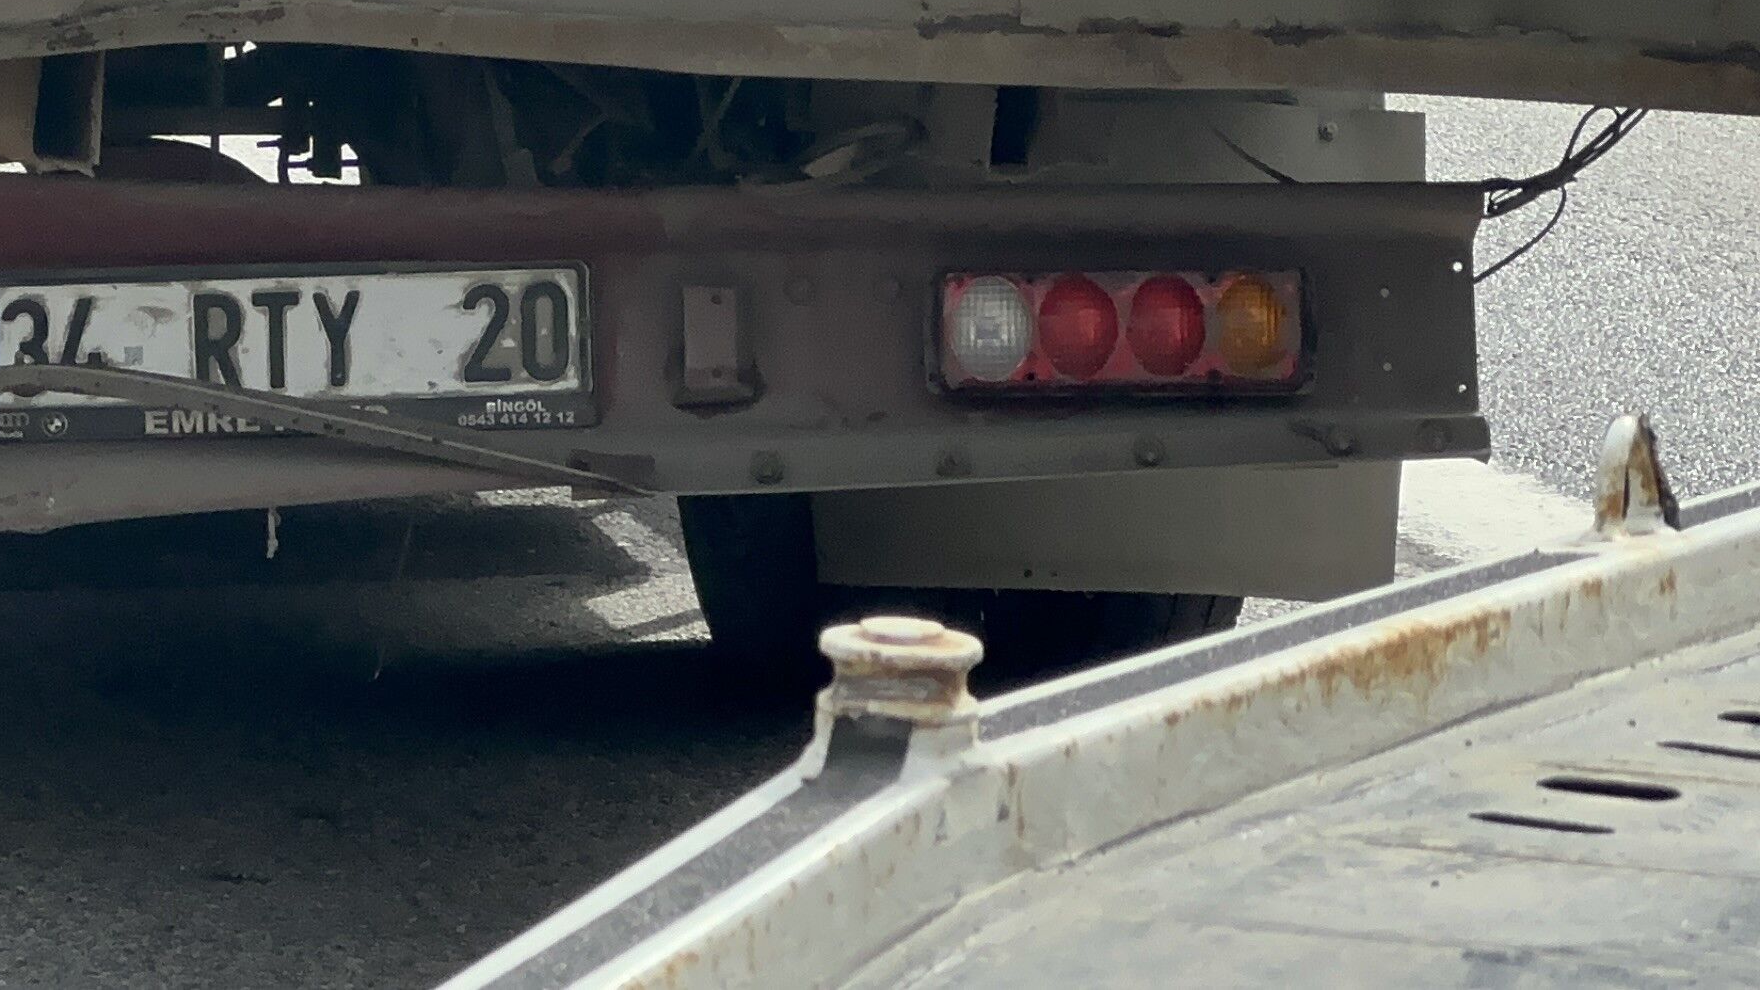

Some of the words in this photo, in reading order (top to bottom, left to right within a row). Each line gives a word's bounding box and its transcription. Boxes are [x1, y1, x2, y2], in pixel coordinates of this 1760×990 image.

[193, 290, 360, 389] RTY
[462, 281, 570, 383] 20
[457, 413, 496, 427] 0543
[500, 412, 528, 425] 414
[533, 411, 552, 424] 12
[556, 410, 575, 424] 12
